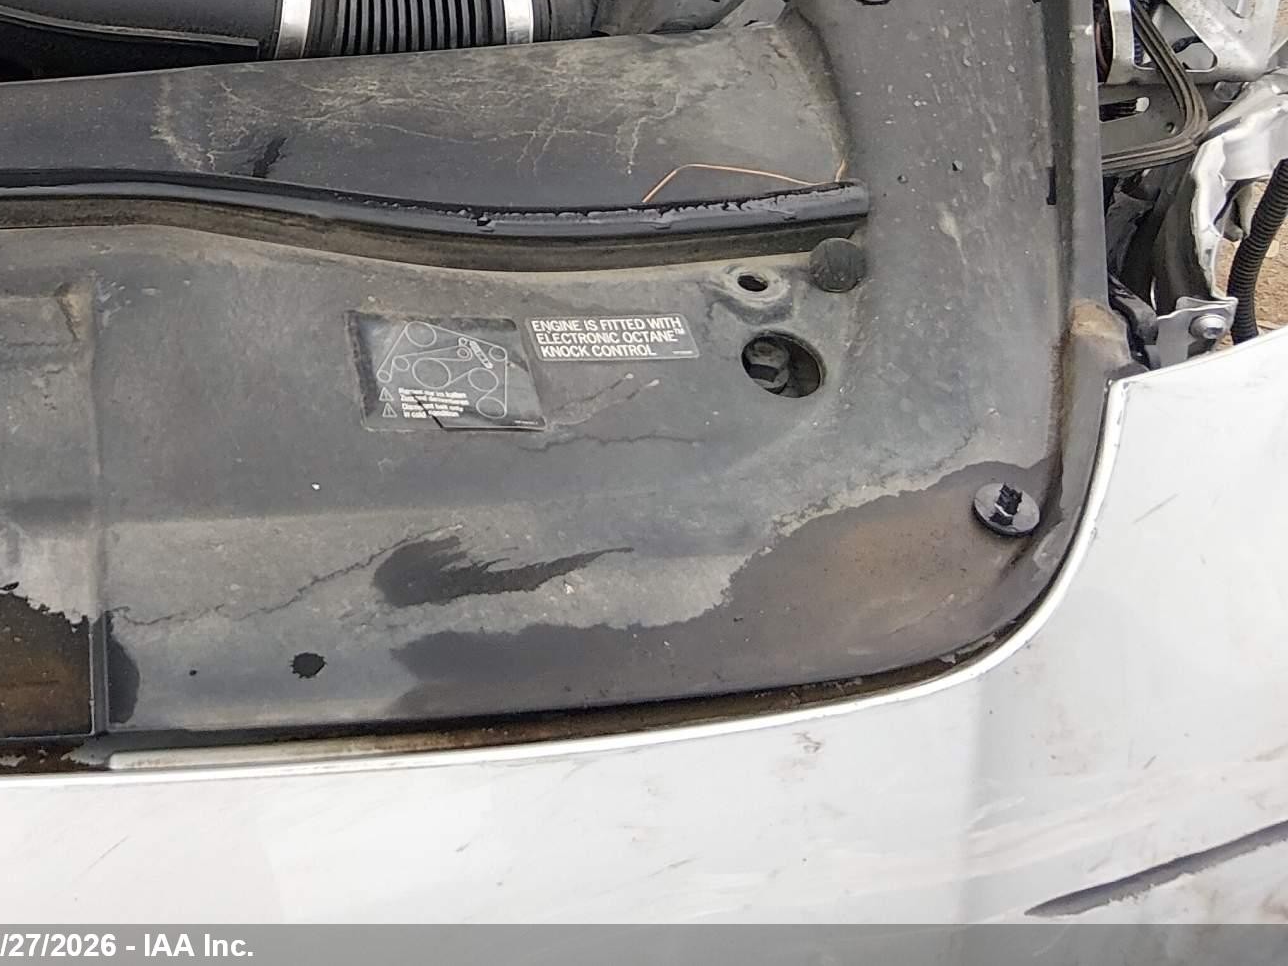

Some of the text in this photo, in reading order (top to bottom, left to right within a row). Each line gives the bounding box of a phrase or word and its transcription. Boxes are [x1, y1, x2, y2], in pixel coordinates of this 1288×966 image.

[531, 316, 682, 332] ENGINE IS FITTED WITH
[536, 332, 620, 345] ELECTRONIC
[541, 344, 657, 358] KNOCK CONTROL
